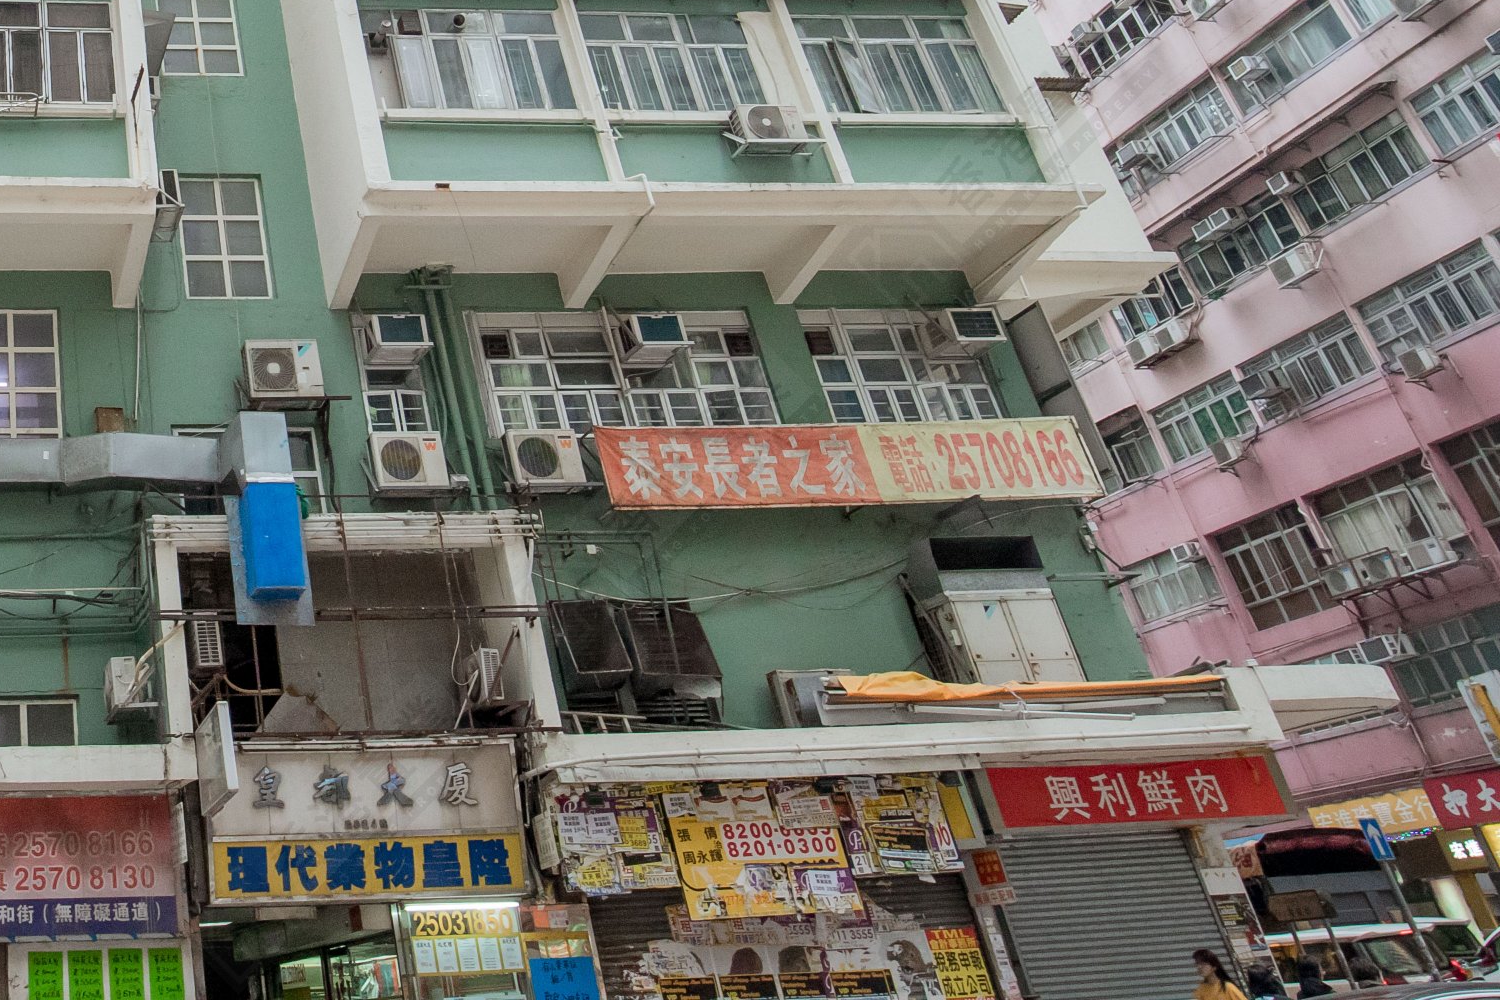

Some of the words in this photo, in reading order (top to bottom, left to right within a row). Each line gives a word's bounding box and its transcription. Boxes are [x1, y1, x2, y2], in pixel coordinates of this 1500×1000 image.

[619, 434, 869, 500] 泰安長者之家
[1046, 768, 1228, 821] 興利鮮肉
[13, 831, 81, 859] 2570
[87, 830, 154, 857] 8166
[14, 866, 81, 892] 2570
[89, 864, 156, 890] 8130
[413, 907, 513, 936] 25031850
[931, 928, 970, 939] TML
[942, 974, 992, 997] 成立公司
